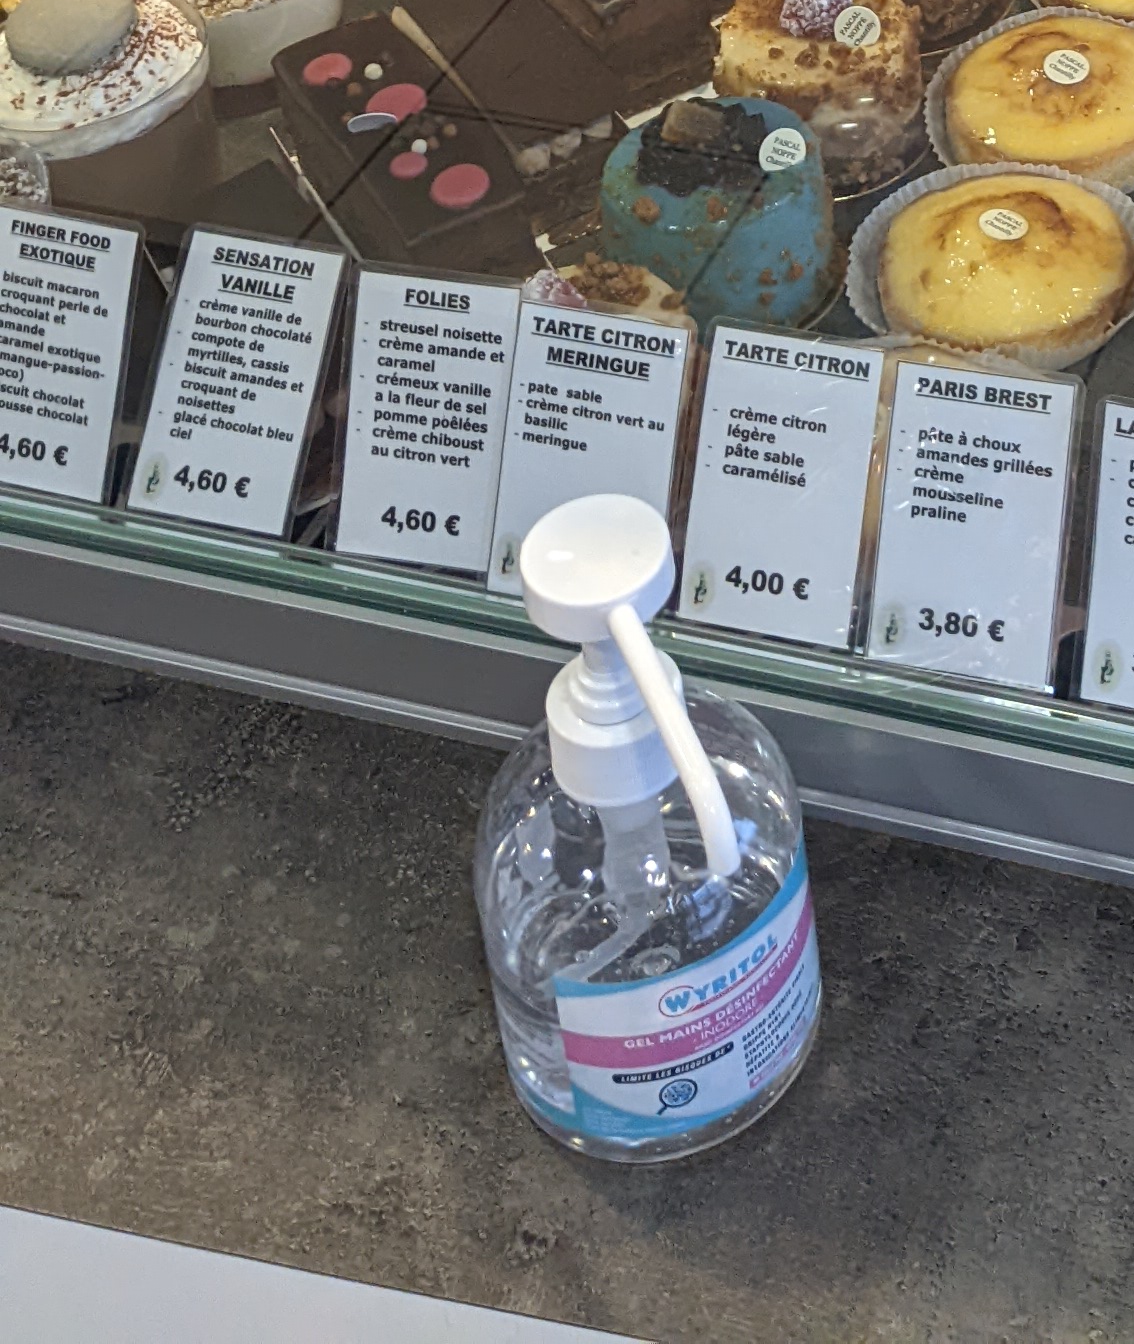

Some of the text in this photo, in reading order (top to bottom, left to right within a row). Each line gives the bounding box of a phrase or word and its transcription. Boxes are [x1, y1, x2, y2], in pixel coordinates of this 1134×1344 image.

[10, 219, 111, 250] FINGER FOOD
[19, 242, 97, 273] EXOTIQUE
[212, 246, 316, 277] SENSATION
[2, 270, 100, 300] biscuit macaron
[221, 273, 296, 301] VANILLE
[404, 287, 471, 311] FOLIES
[0, 288, 109, 318] croquant perle de
[199, 298, 303, 326] crème vanille de
[194, 312, 313, 345] bourbon chocolaté
[379, 319, 503, 346] streusel noisette
[532, 315, 676, 355] TARTE CITRON
[378, 335, 505, 364] crème amande et
[546, 345, 651, 379] MERINGUE
[724, 339, 871, 379] TARTE CITRON
[917, 376, 1053, 411] PARIS BREST
[524, 412, 569, 432] basilic
[525, 397, 665, 432] crème citron vert au
[729, 406, 827, 434] crème citron
[0, 432, 69, 467] 4,60 €
[521, 431, 588, 452] meringue
[726, 423, 776, 445] légère
[722, 463, 807, 488] caramélisé
[915, 447, 1054, 478] amandes grillées
[173, 464, 251, 499] 4,60 €
[912, 486, 1004, 510] mousseline
[380, 505, 461, 537] 4,60 €
[910, 504, 967, 524] praline
[724, 565, 810, 601] 4,00 €
[918, 607, 1006, 643] 3,80 €
[664, 934, 778, 1012] WYRITOL
[624, 1038, 655, 1049] GEL
[659, 1017, 711, 1043] MAINS
